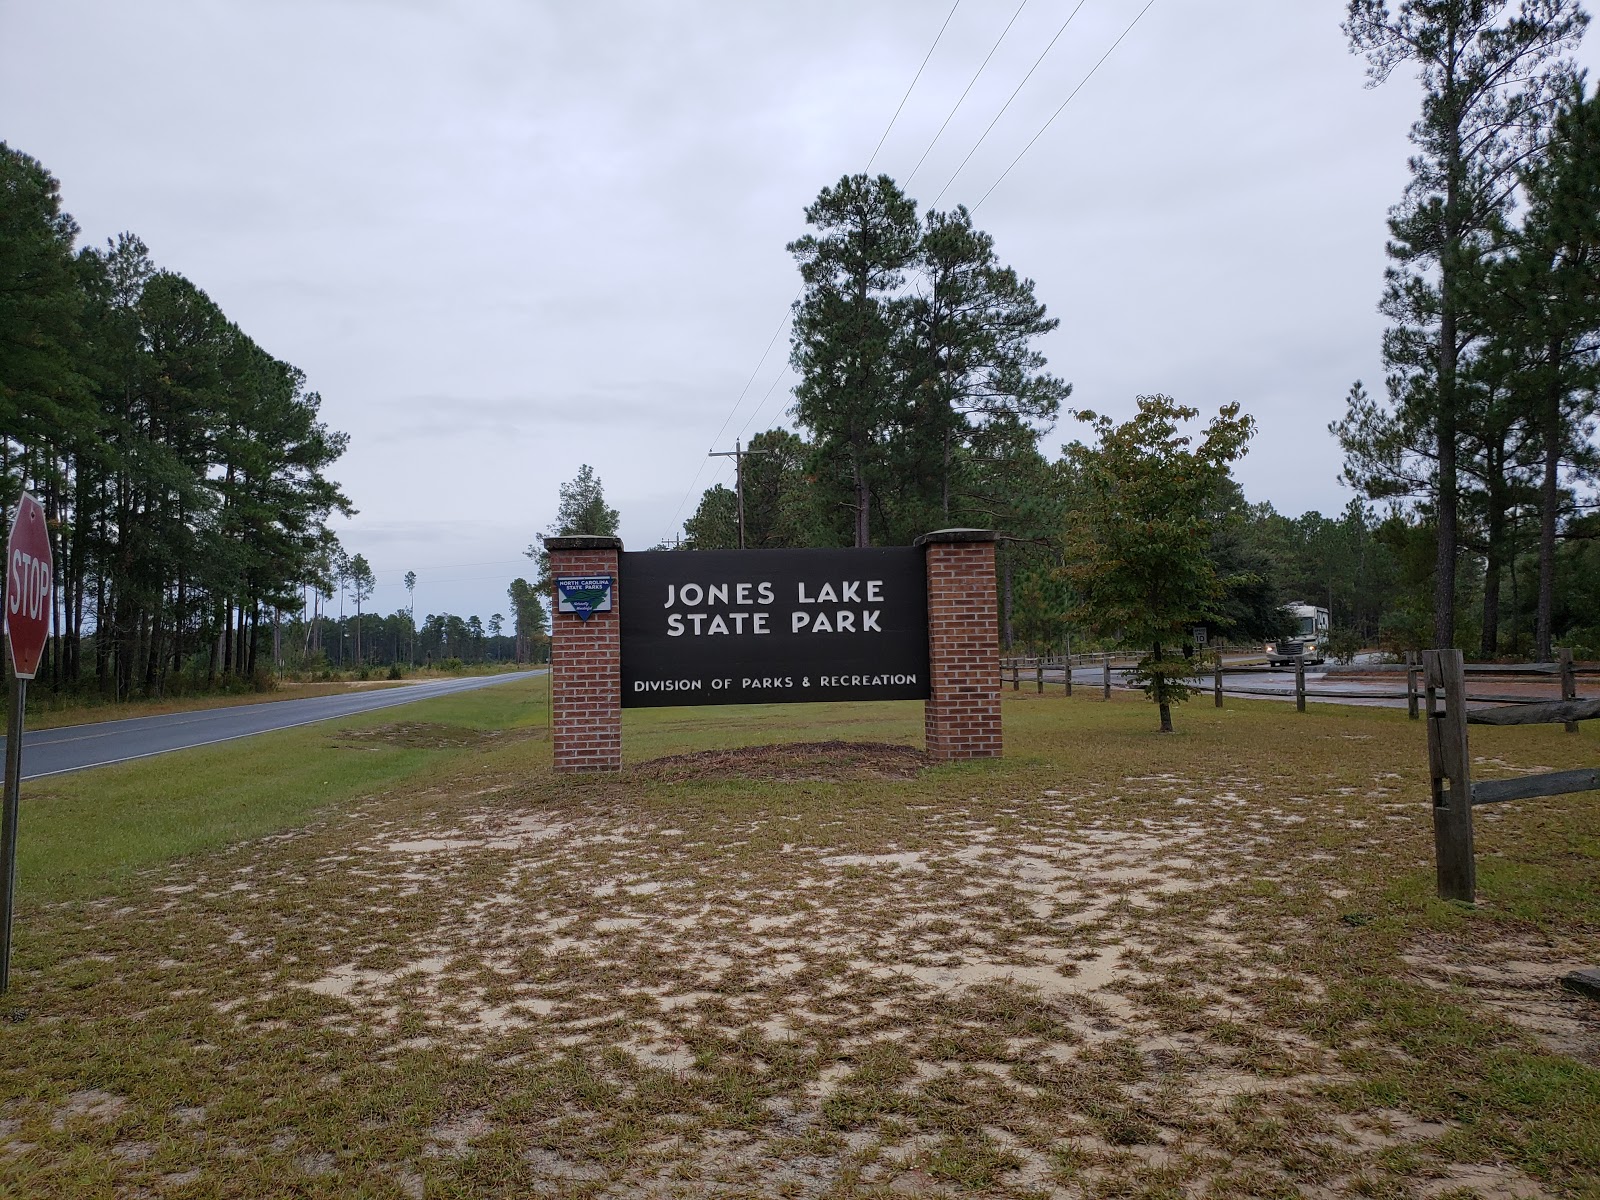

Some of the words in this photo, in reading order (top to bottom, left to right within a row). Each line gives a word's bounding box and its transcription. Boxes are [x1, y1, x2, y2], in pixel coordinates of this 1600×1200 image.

[10, 548, 49, 621] STOP
[664, 581, 775, 609] JONES
[798, 580, 885, 604] LAKE
[666, 612, 771, 637] STATE
[791, 610, 882, 634] PARK
[634, 679, 702, 692] DIVISION
[711, 678, 733, 690] OF
[742, 676, 794, 689] PARKS
[802, 676, 811, 688] &
[820, 673, 917, 687] RECREATION
